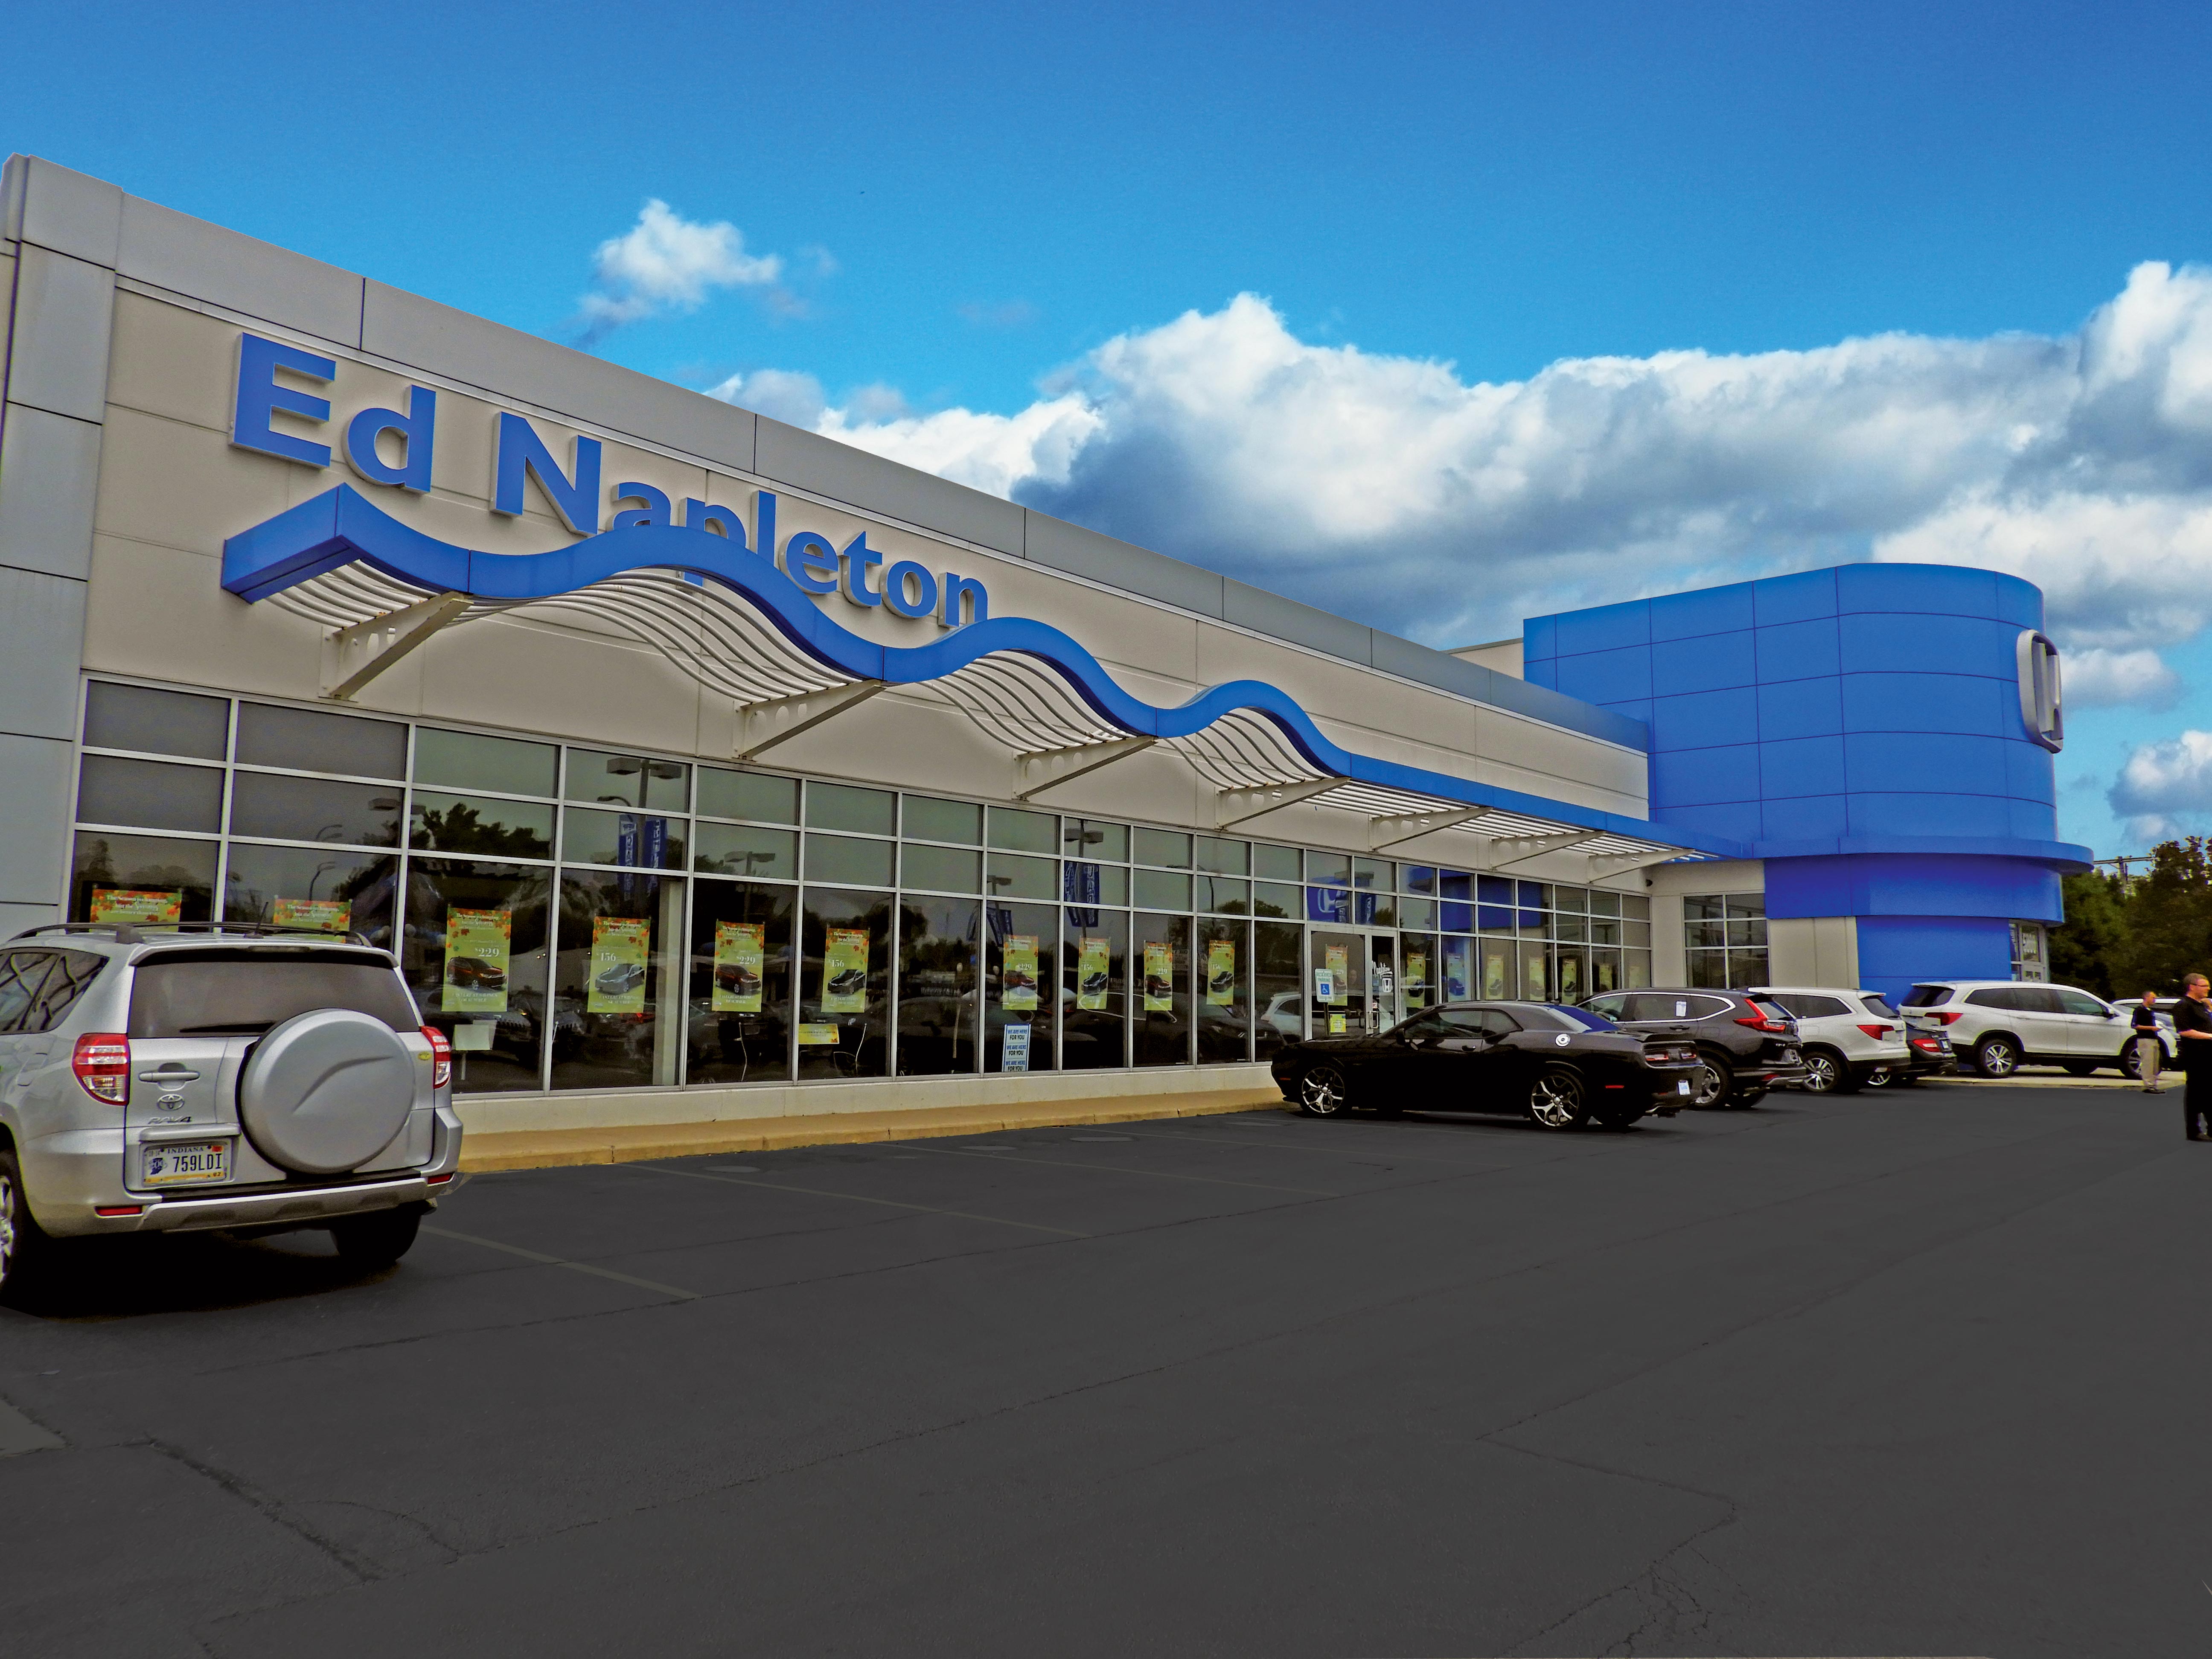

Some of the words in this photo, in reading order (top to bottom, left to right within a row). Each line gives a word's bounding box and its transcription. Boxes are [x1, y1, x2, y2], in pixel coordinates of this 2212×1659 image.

[230, 332, 437, 493] Ed
[148, 1116, 192, 1124] RAV4
[172, 1153, 222, 1173] 759LDI
